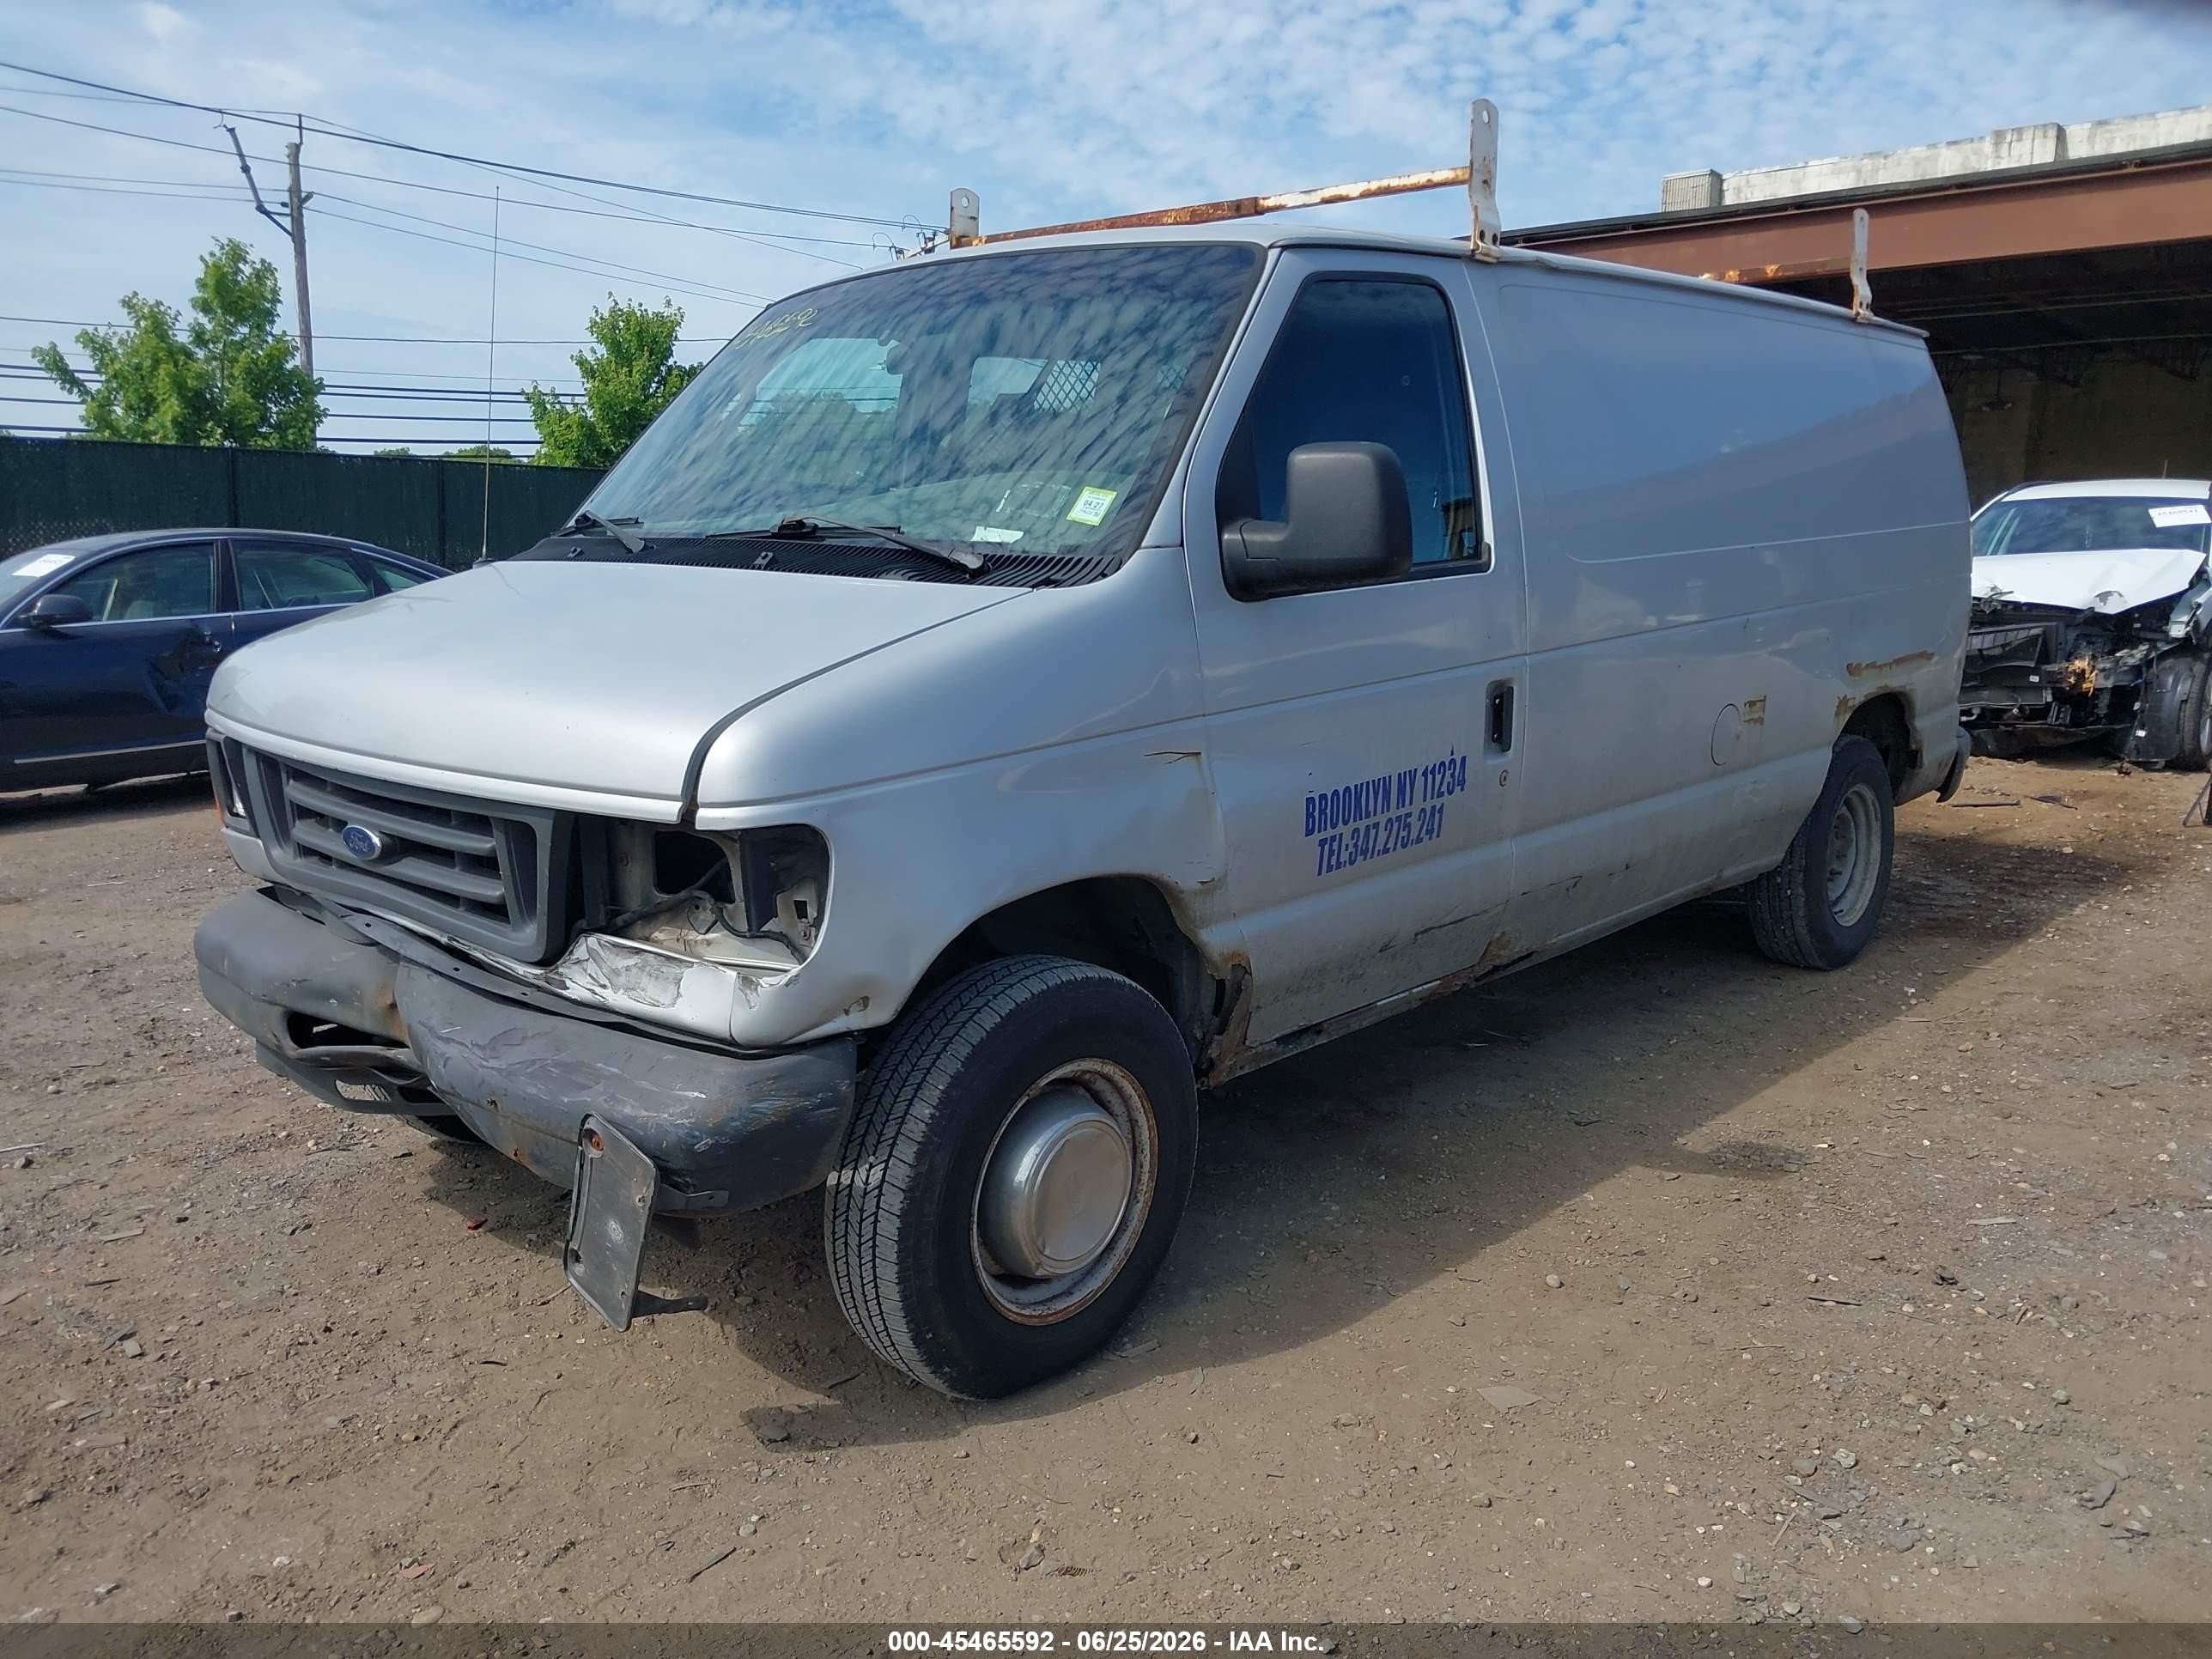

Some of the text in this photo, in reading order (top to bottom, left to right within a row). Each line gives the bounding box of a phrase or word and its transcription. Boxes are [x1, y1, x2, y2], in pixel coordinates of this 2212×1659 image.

[1304, 756, 1468, 838] BROOKLYN NY 11234
[349, 831, 370, 852] Ford
[1316, 802, 1444, 877] TEL:347.275.241
